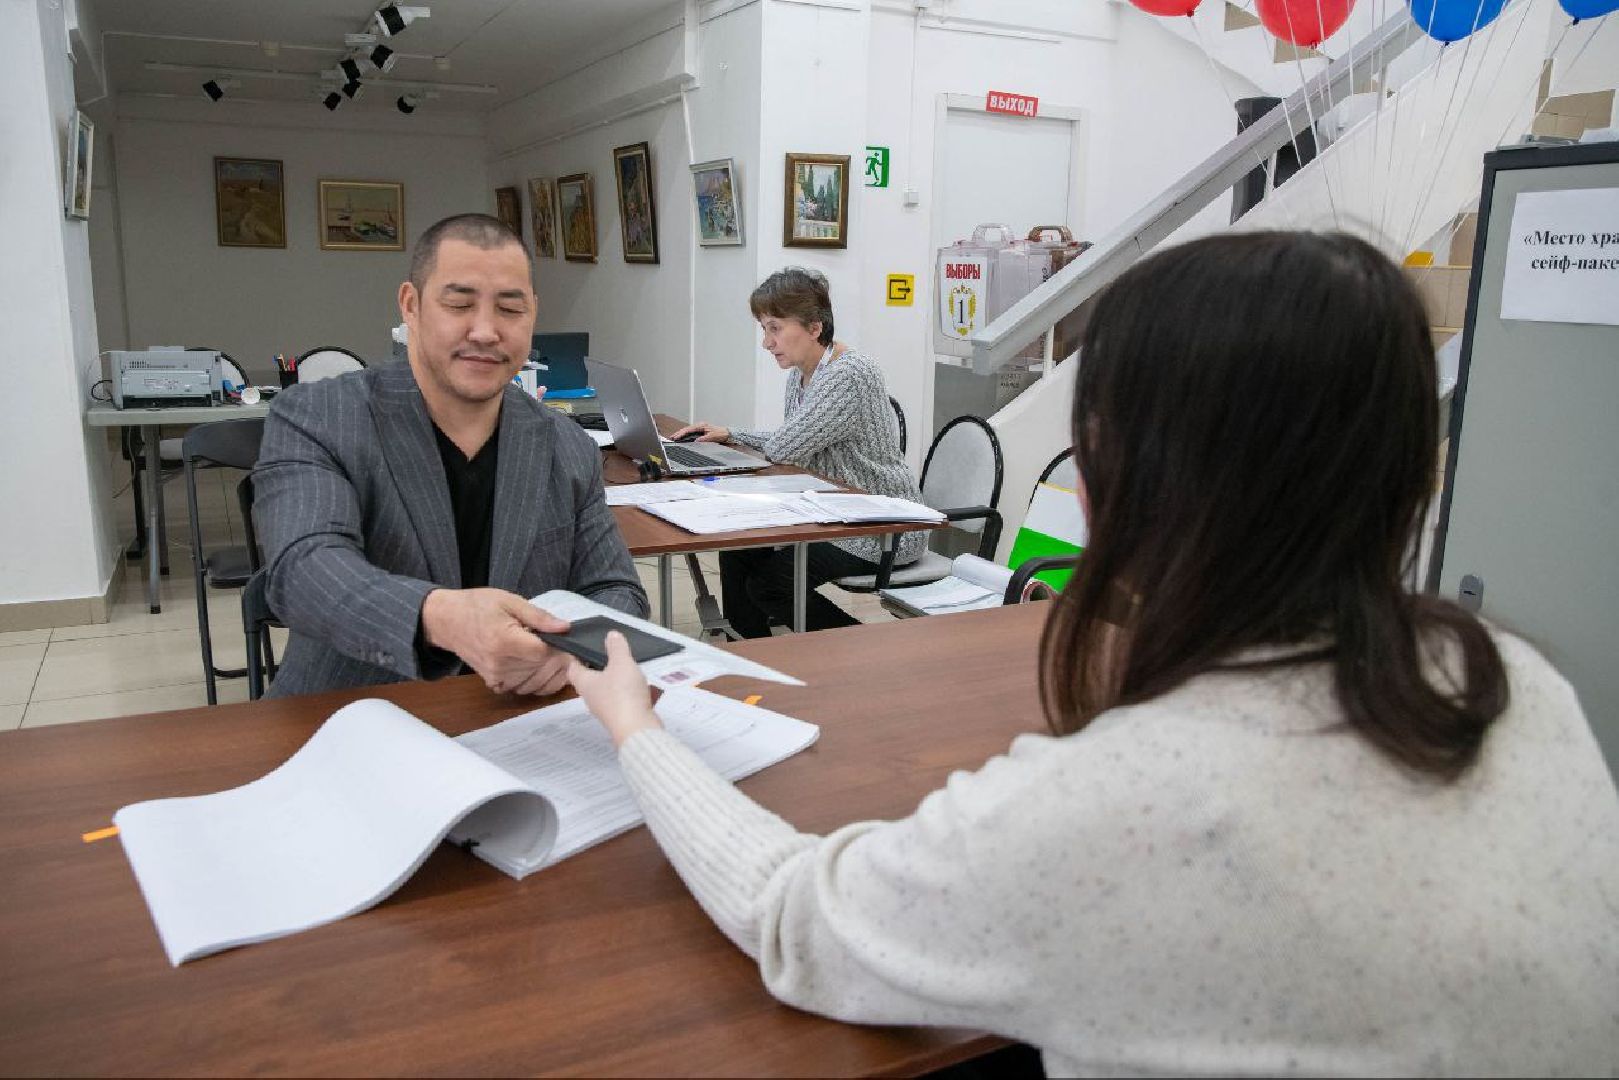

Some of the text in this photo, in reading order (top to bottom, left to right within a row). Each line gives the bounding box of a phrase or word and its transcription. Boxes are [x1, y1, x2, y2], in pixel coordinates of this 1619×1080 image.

[989, 95, 1035, 116] ВЫХОД
[1523, 230, 1586, 246] «Место
[945, 263, 981, 280] ВЫБОРЫ
